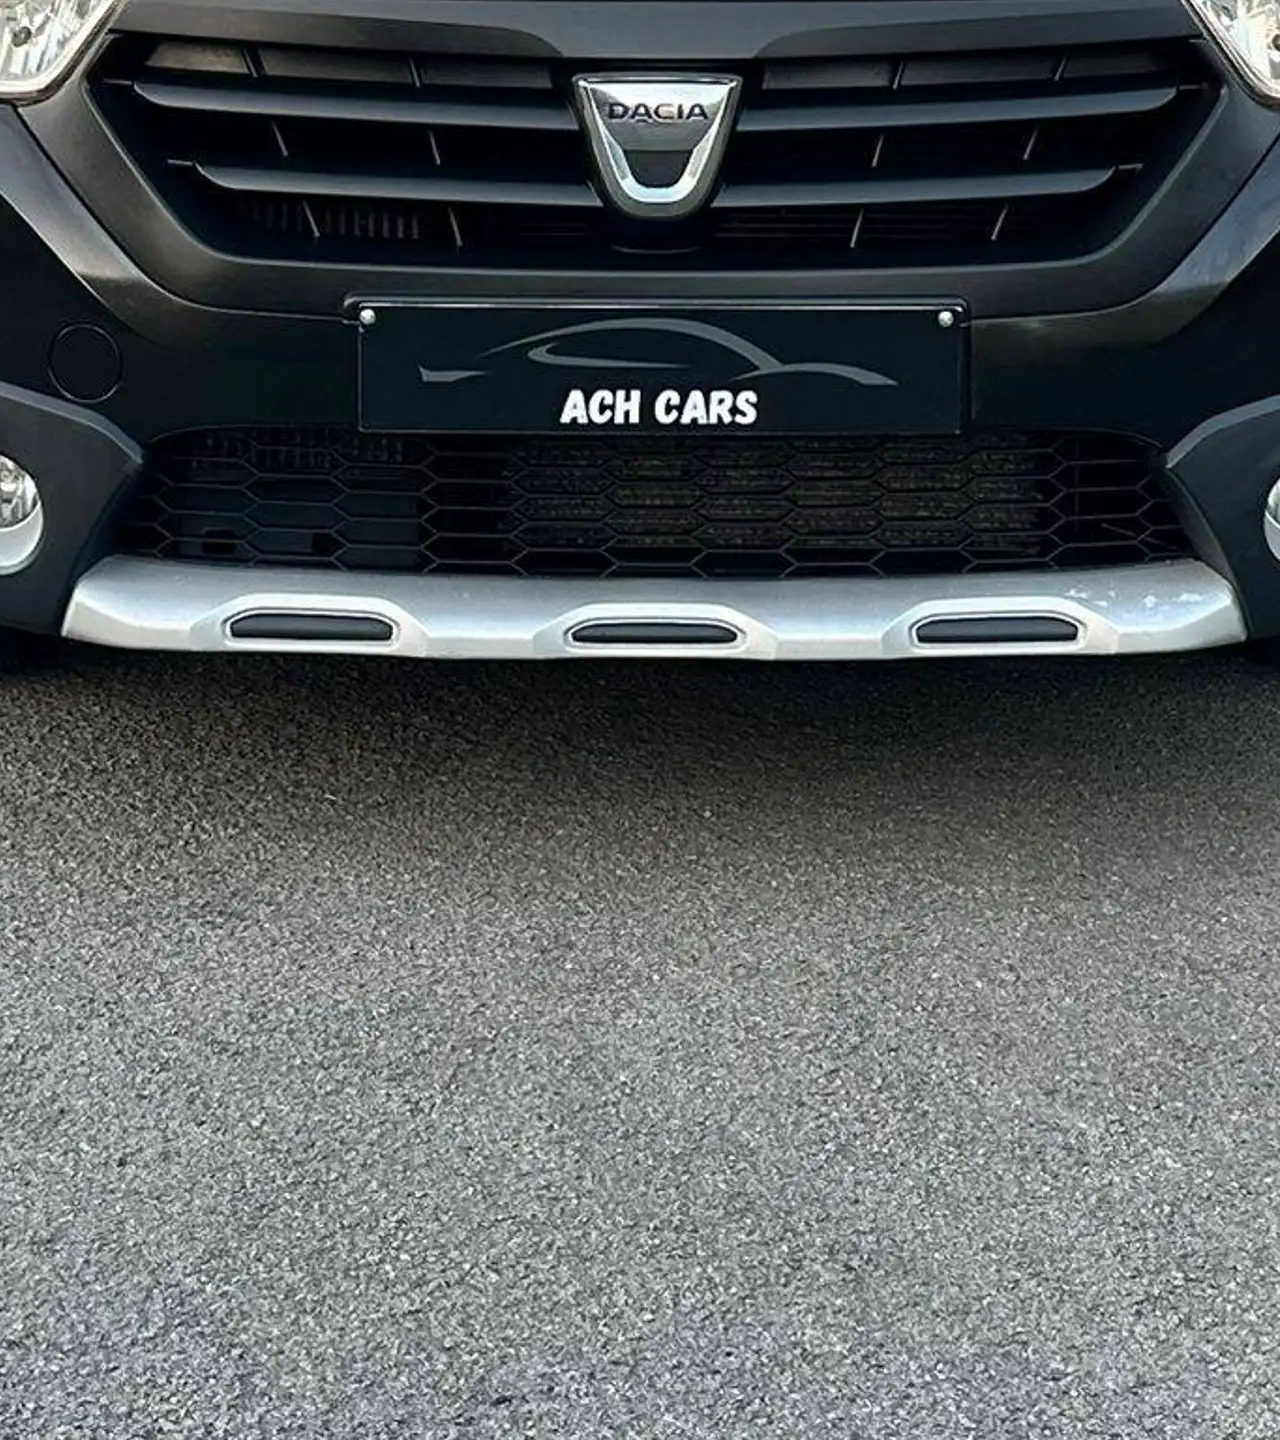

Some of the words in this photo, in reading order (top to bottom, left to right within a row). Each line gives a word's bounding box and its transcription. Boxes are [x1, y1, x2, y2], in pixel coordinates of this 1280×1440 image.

[607, 102, 709, 122] DACIA
[559, 389, 640, 425] ACH
[654, 389, 758, 425] CARS
